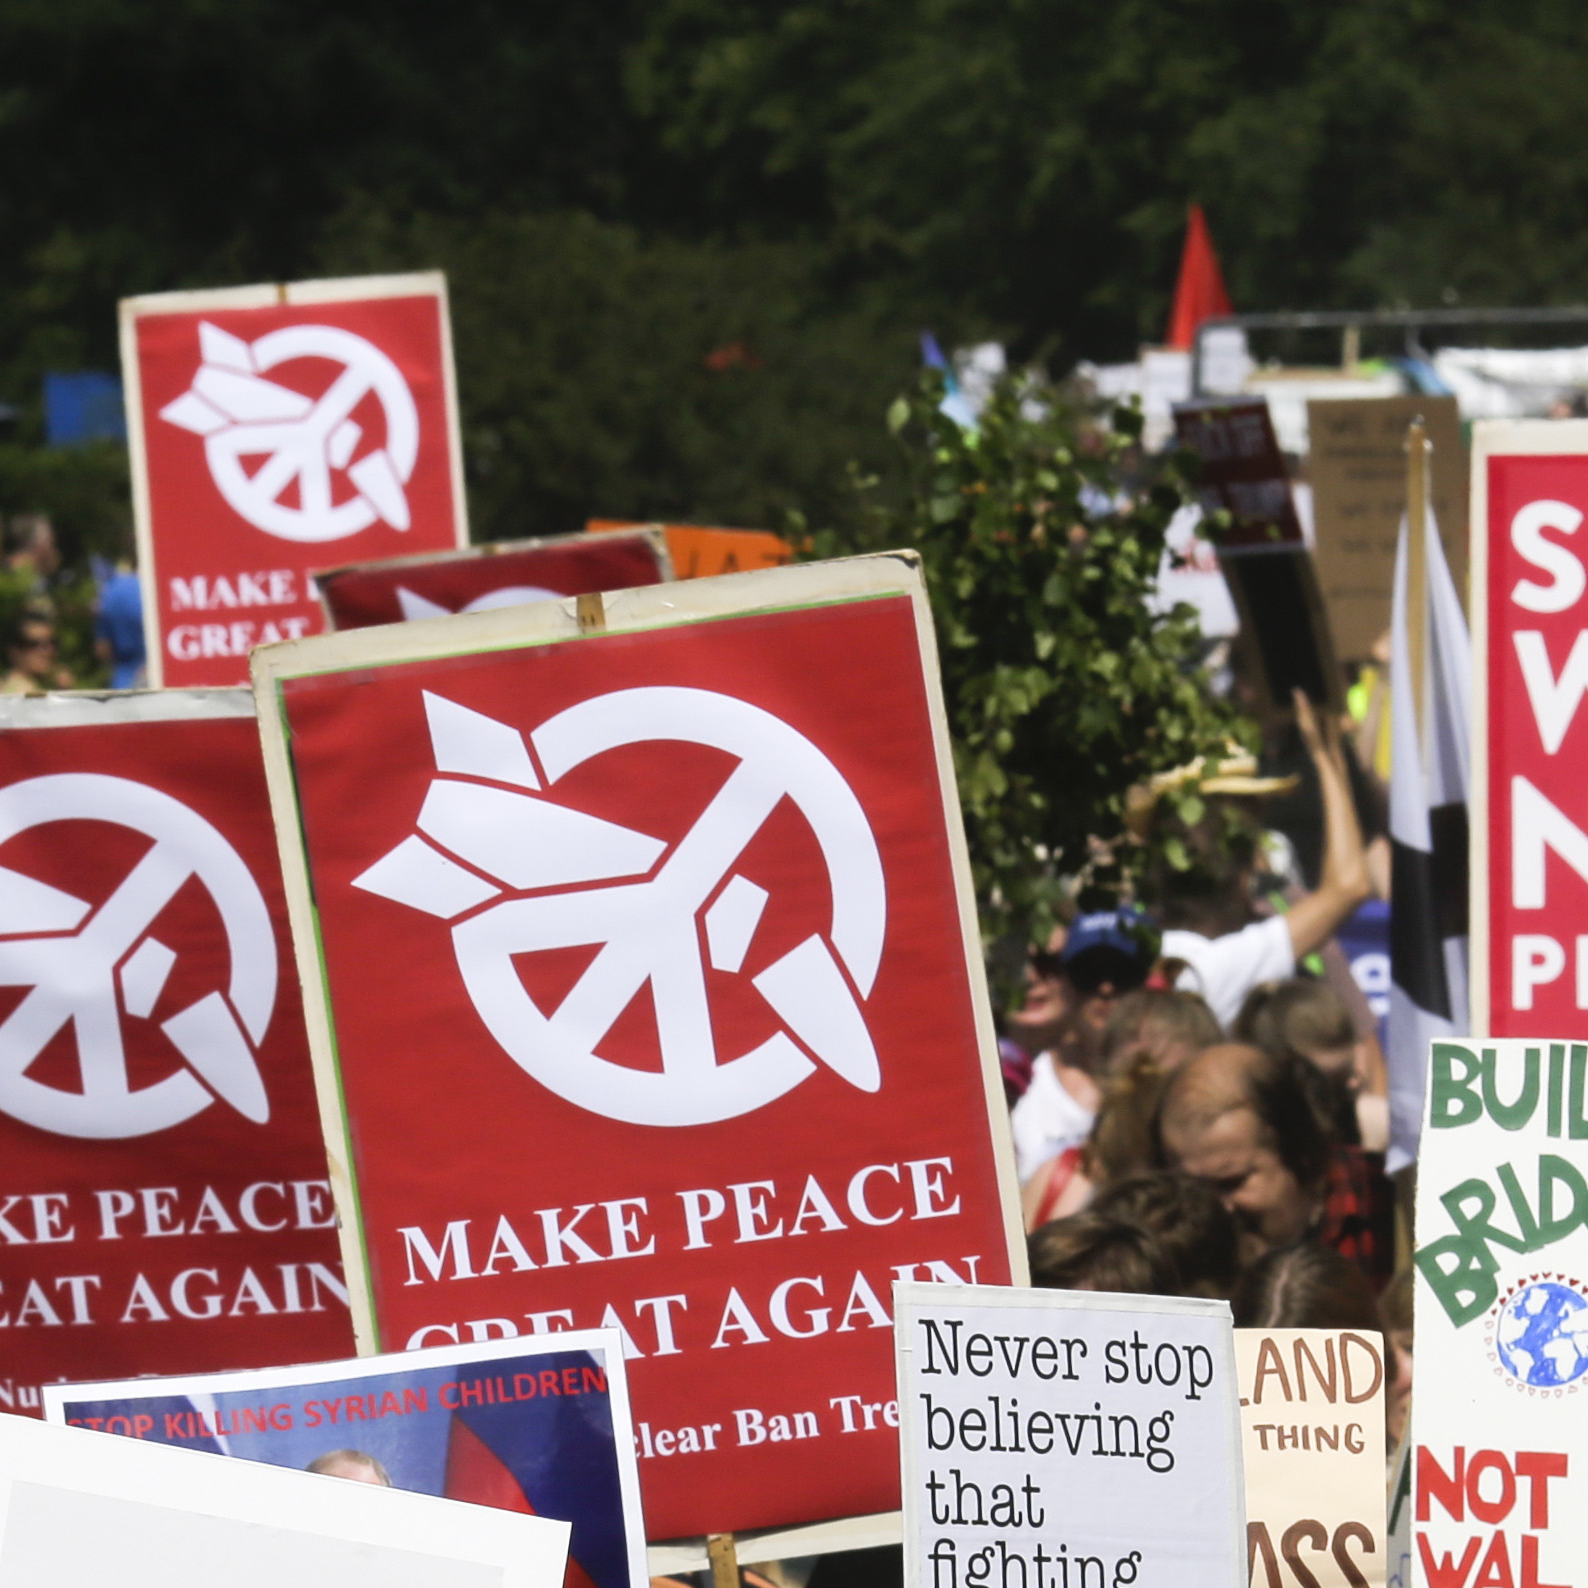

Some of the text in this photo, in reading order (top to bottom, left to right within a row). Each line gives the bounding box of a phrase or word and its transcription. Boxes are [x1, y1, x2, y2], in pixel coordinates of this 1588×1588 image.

[170, 569, 297, 611] MAKE
[94, 1180, 340, 1240] PEACE
[396, 1157, 961, 1287] MAKE PEACE
[918, 1318, 1214, 1400] Never stop
[164, 1403, 294, 1440] KILLING
[305, 1388, 429, 1430] SYRIAN
[437, 1366, 607, 1410] CHILDREN
[733, 1405, 820, 1447] Ban
[829, 1396, 900, 1434] Tre
[919, 1393, 1174, 1473] believing
[925, 1469, 1044, 1527] that
[1415, 1444, 1568, 1529] NOT
